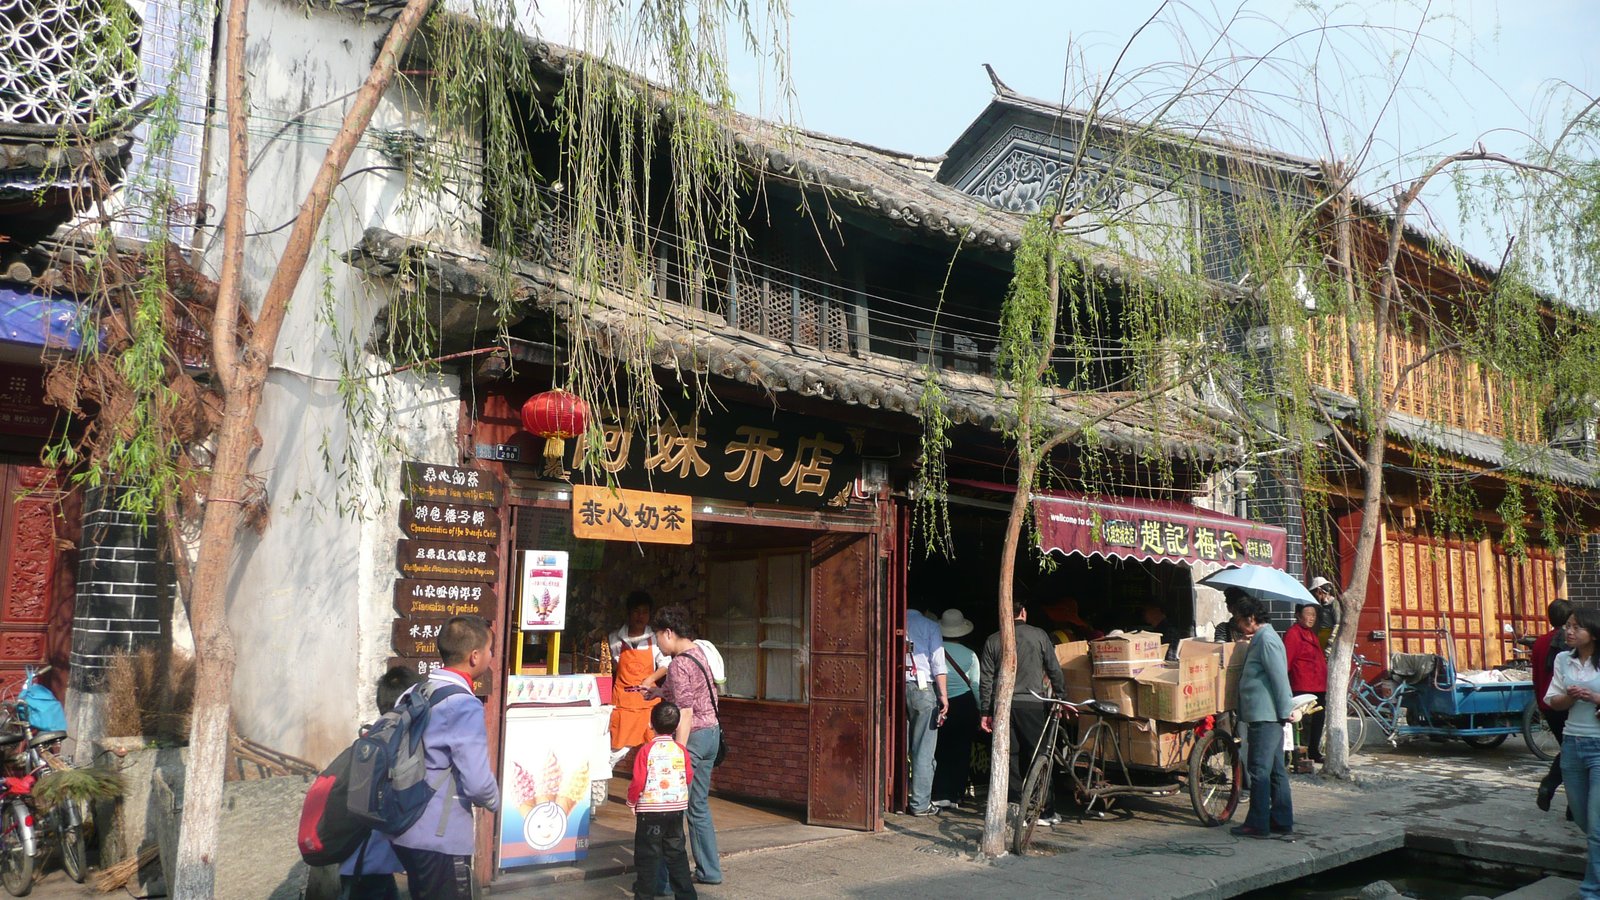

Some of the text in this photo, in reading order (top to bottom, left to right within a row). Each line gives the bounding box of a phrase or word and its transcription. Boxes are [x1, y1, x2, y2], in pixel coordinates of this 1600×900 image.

[572, 406, 844, 497] 阿妹开店
[1078, 518, 1085, 526] to
[447, 603, 455, 615] of
[456, 604, 479, 615] potato
[415, 641, 436, 653] Fruit
[646, 824, 661, 836] 78
